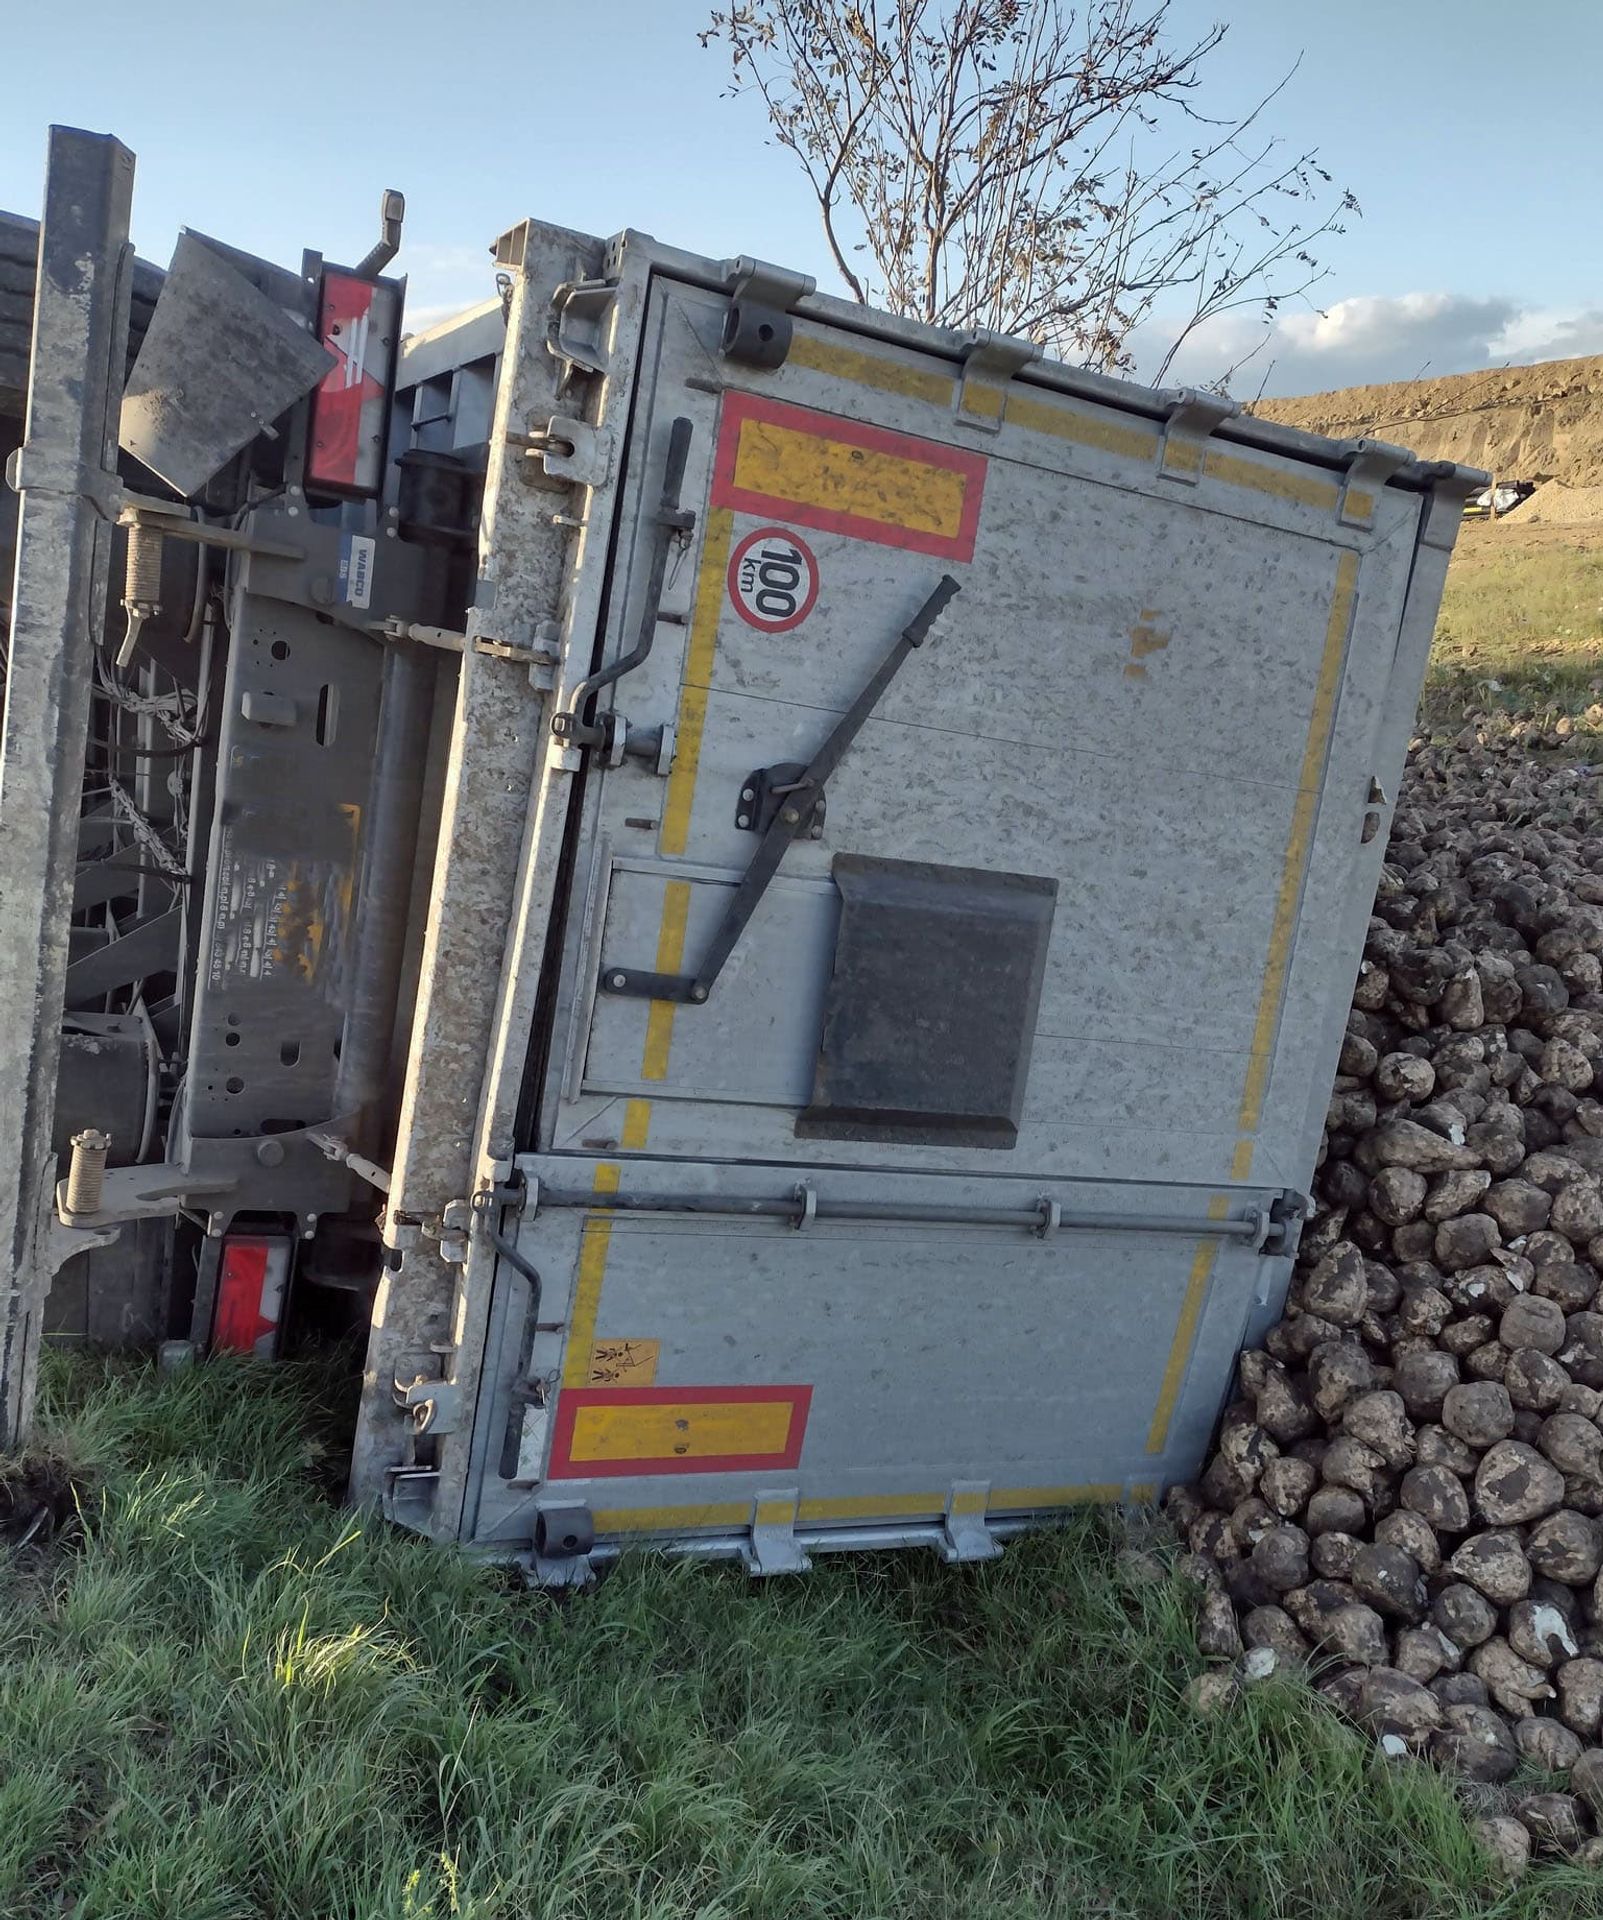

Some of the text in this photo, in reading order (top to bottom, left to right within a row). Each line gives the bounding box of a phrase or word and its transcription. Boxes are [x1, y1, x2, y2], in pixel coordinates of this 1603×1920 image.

[355, 549, 368, 597] WABCO
[740, 557, 762, 593] km
[756, 548, 802, 618] 100
